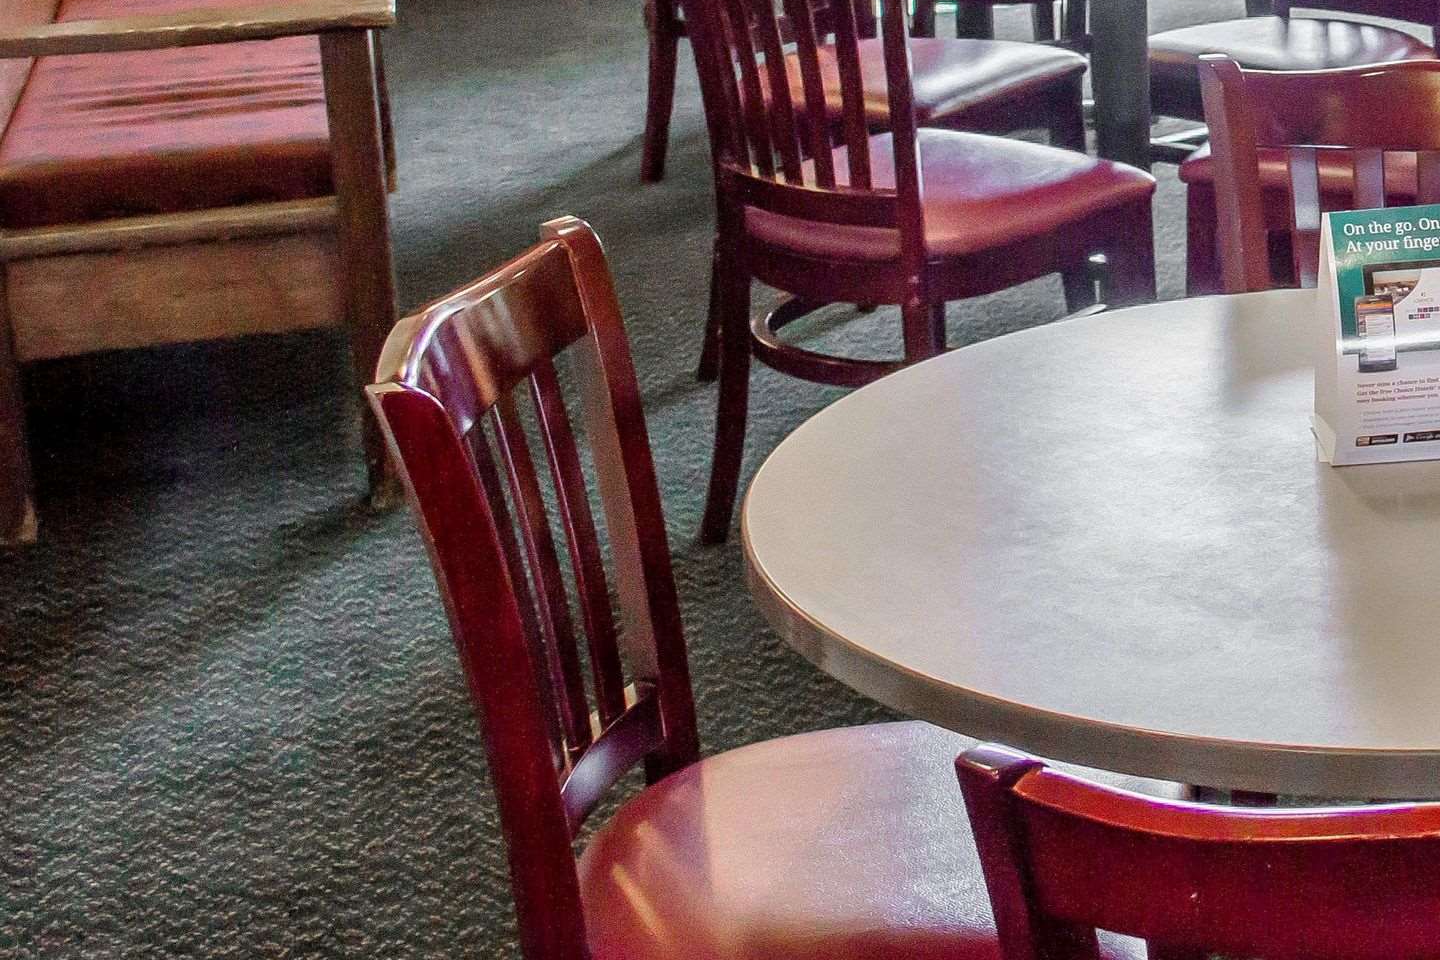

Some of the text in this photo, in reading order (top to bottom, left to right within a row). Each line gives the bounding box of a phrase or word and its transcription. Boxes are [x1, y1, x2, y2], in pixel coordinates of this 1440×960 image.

[1343, 223, 1365, 236] On
[1368, 220, 1392, 234] the
[1395, 222, 1416, 235] go.
[1418, 217, 1440, 231] On
[1346, 240, 1363, 254] At
[1366, 239, 1399, 255] your
